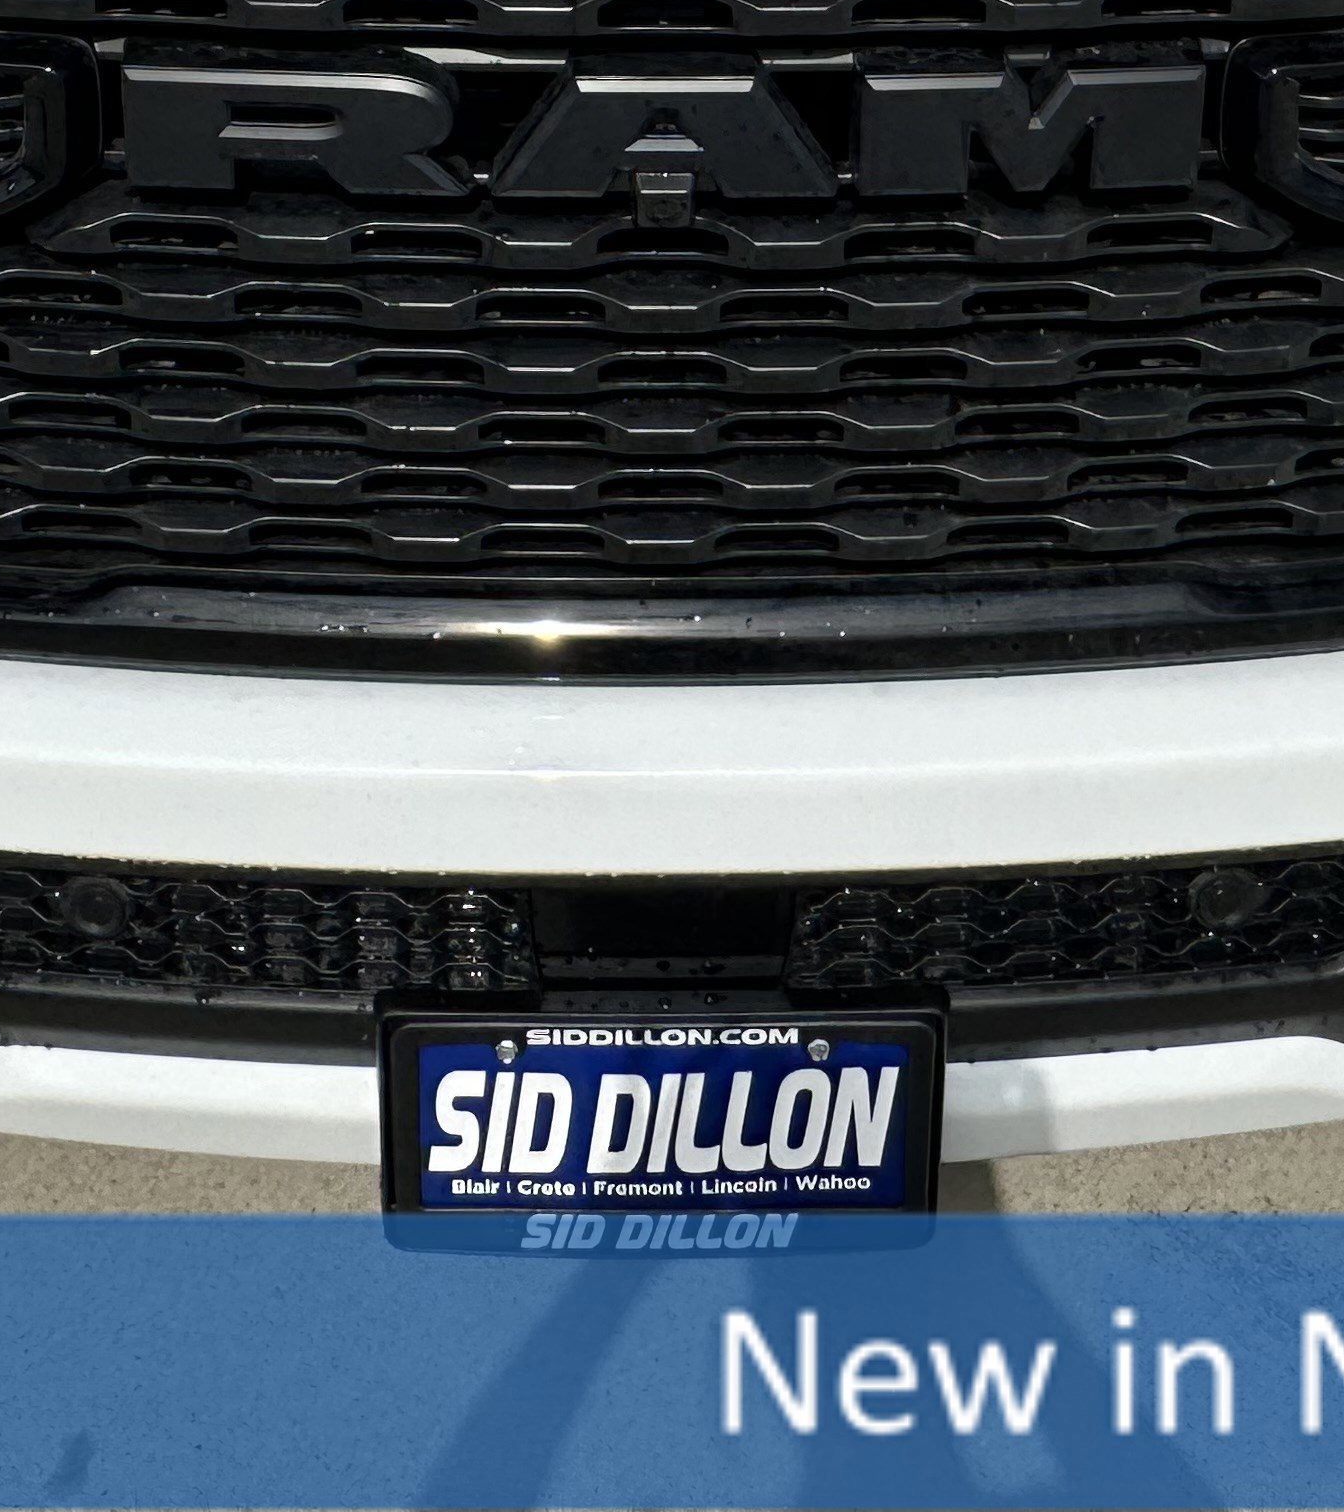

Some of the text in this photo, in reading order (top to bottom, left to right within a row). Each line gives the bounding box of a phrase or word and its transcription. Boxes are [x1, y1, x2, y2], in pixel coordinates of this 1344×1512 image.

[122, 51, 1206, 199] RAM
[525, 1027, 799, 1047] SIDDILLON.COM
[427, 1066, 899, 1174] SID DILLON
[451, 1178, 499, 1195] Blair
[701, 1176, 777, 1196] Lincoln
[794, 1173, 871, 1191] Wahoo
[521, 1213, 798, 1250] SID DILLON
